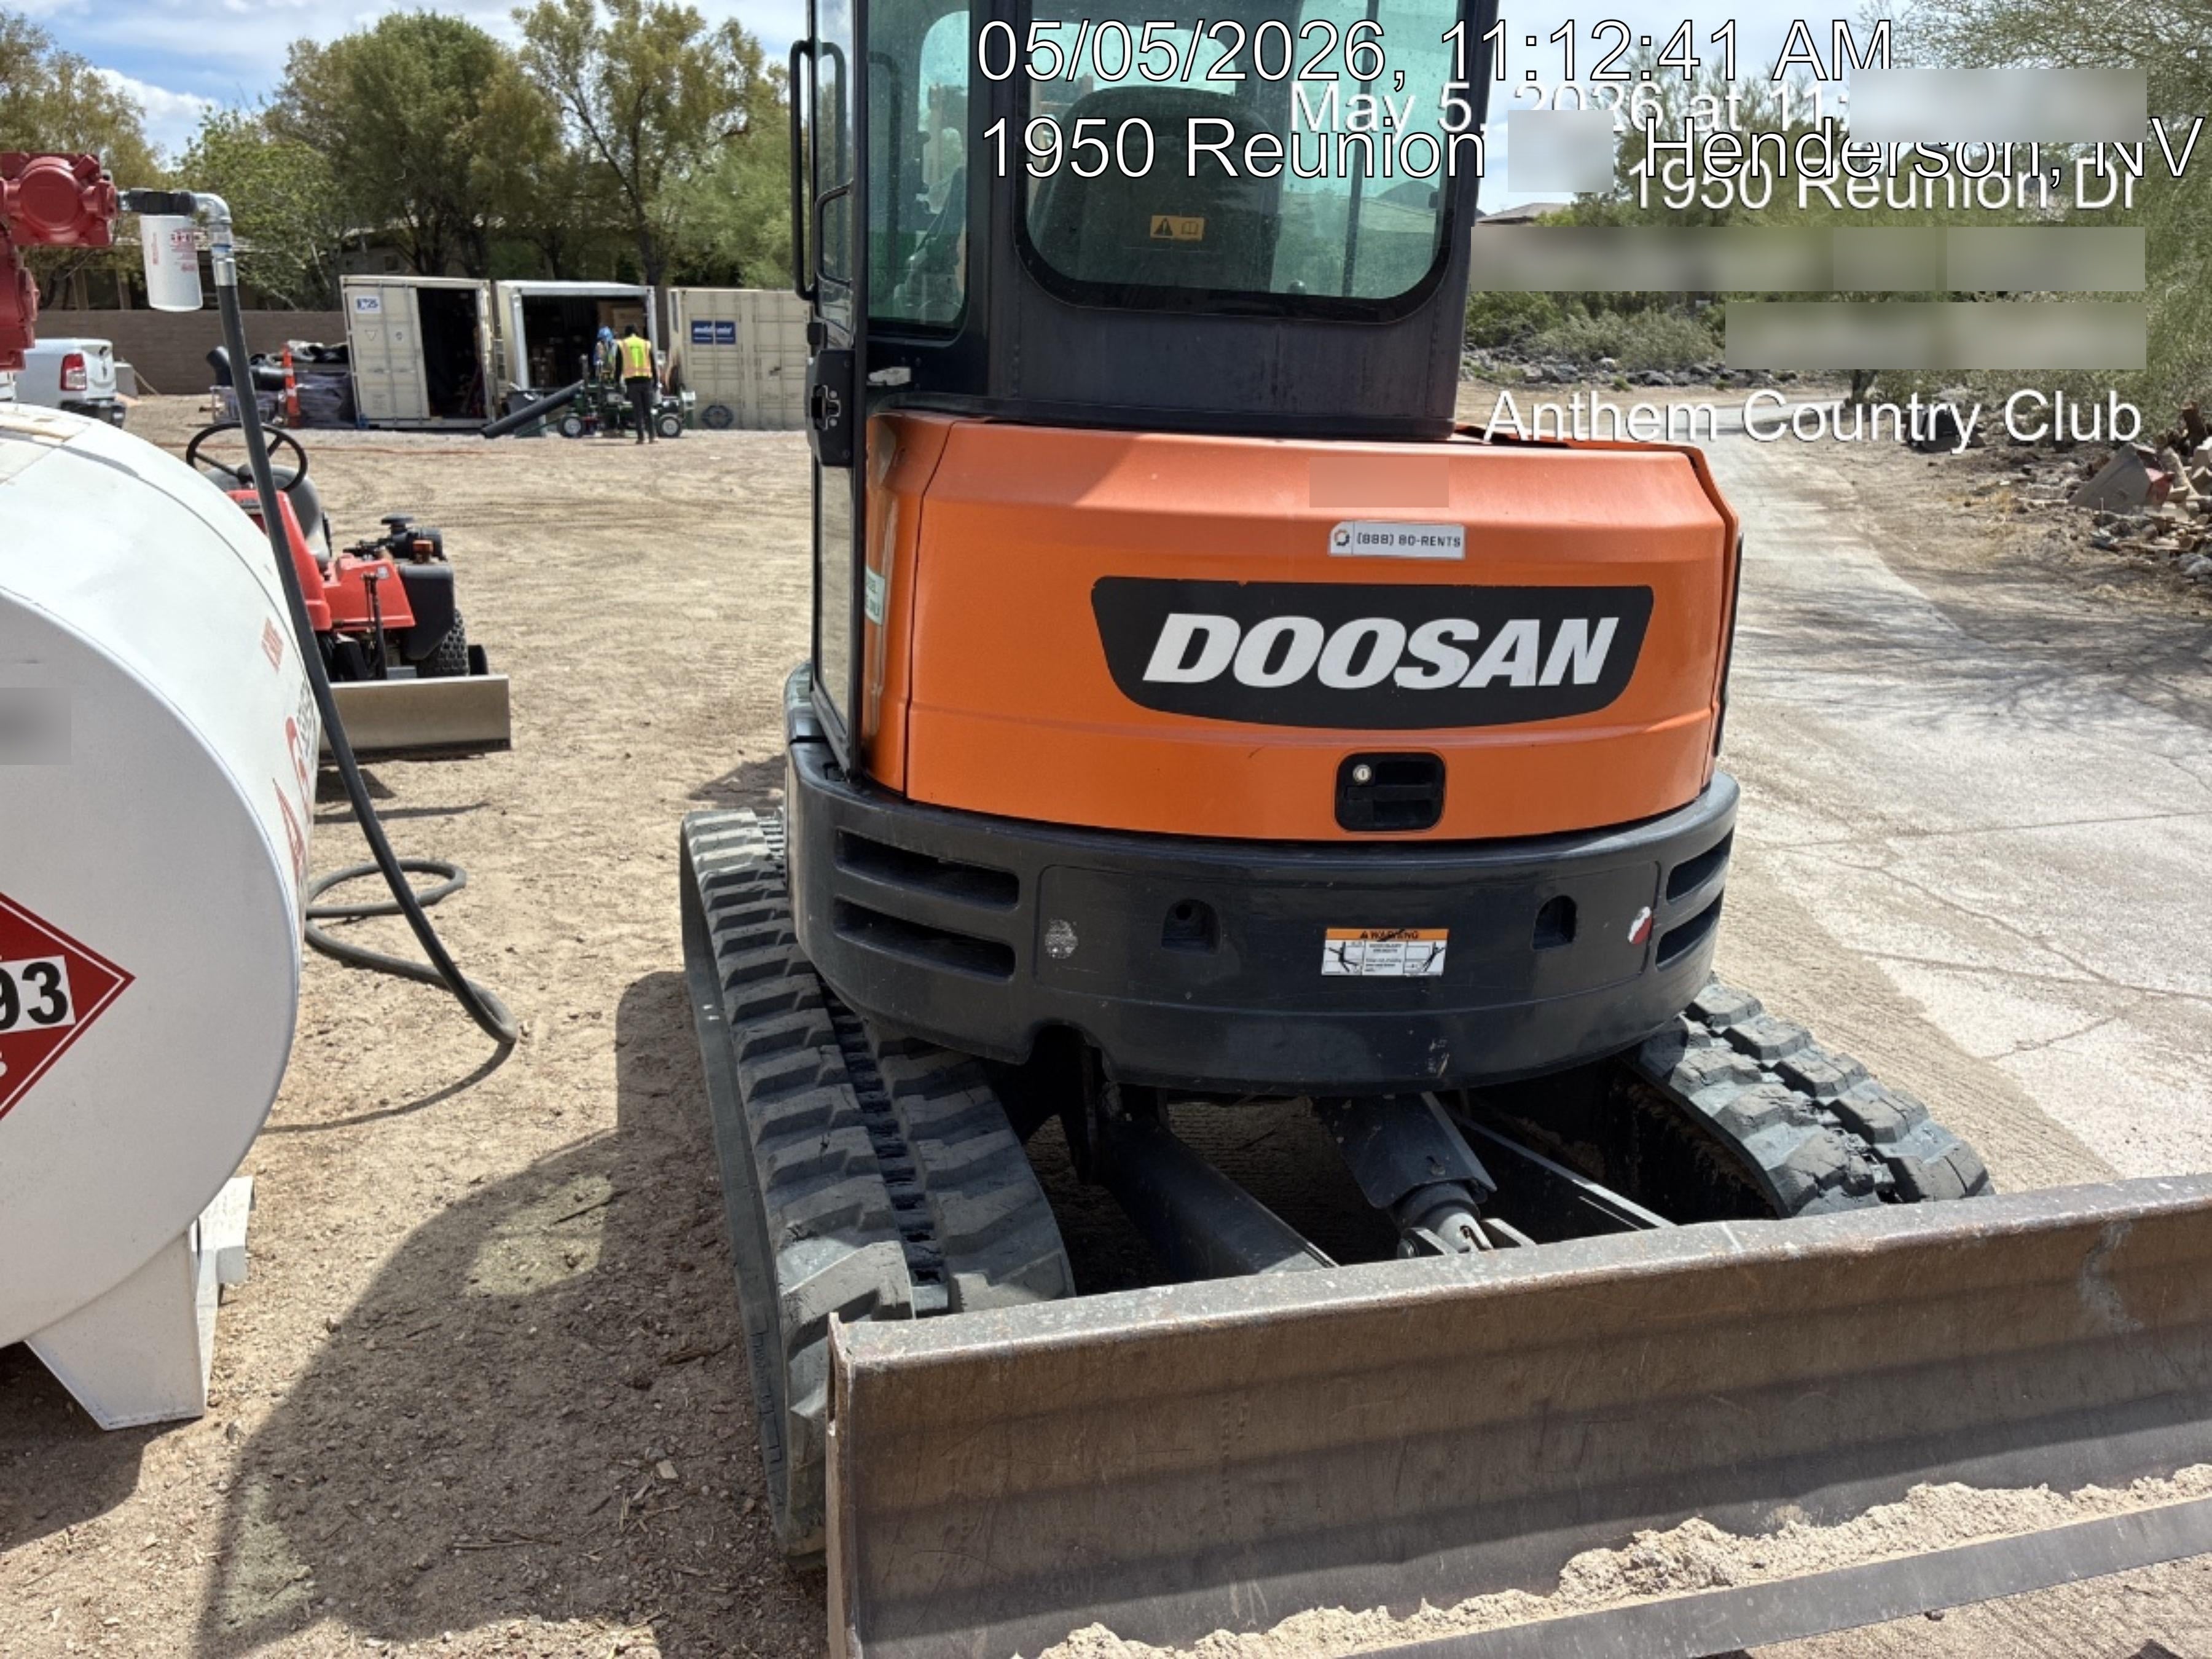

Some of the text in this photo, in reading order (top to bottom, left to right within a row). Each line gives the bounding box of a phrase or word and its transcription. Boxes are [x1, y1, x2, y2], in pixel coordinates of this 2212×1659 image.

[1356, 532, 1461, 548] (888) 80-RENTS
[1143, 613, 1619, 689] DOOSAN
